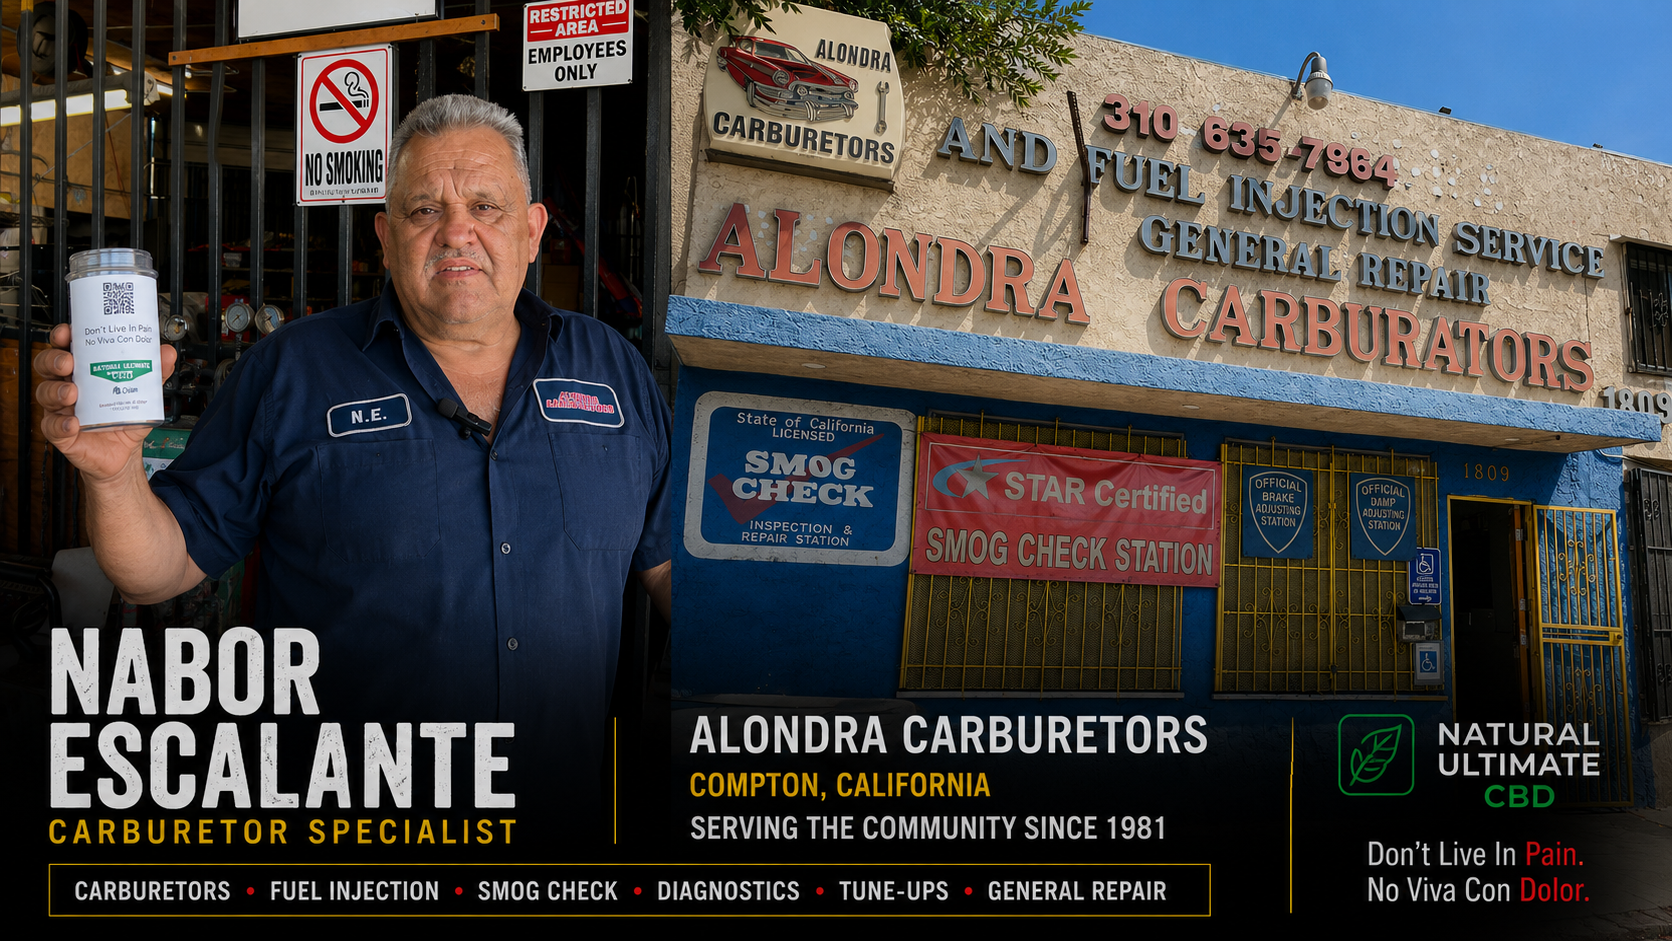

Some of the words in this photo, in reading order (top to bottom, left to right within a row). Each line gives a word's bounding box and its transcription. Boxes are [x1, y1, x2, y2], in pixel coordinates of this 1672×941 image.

[530, 0, 627, 23] RESTRICTED
[555, 19, 599, 37] AREA
[528, 40, 627, 64] EMPLOYEES
[814, 38, 891, 73] ALONDRA
[555, 63, 597, 82] ONLY
[1101, 93, 1179, 143] 310
[713, 111, 895, 164] CARBURETORS
[305, 153, 323, 186] NO
[326, 149, 383, 185] SMOKING
[937, 116, 1058, 175] AND
[1086, 144, 1206, 205] FUEL
[1228, 174, 1440, 247] INJECTION
[1453, 221, 1606, 280] SERVICE
[1139, 214, 1342, 283] GENERAL
[1357, 251, 1491, 306] REPAIR
[698, 202, 1090, 326] ALONDRA
[1161, 277, 1595, 393] CARBURATORS
[85, 326, 106, 336] Don't
[108, 325, 126, 333] Live
[128, 324, 136, 332] In
[85, 338, 96, 346] No
[117, 335, 134, 343] Con
[1602, 386, 1672, 424] 1809
[351, 408, 387, 424] N.E.
[737, 412, 777, 427] State
[785, 416, 801, 428] of
[810, 417, 874, 434] California
[772, 428, 835, 442] LICENSED
[745, 450, 856, 480] SMOG
[1464, 462, 1509, 482] 1809
[732, 477, 874, 508] CHECK
[1004, 471, 1085, 505] STAR
[1094, 479, 1207, 514] Certified
[1255, 477, 1302, 493] OFFICIAL
[1361, 484, 1405, 498] OFFICIAL
[1262, 492, 1295, 503] BRAKE
[1255, 503, 1301, 516] ADJUSTING
[1362, 508, 1405, 520] ADJUSTING
[750, 520, 833, 534] INSPECTION
[843, 525, 853, 535] &
[1261, 516, 1296, 527] STATION
[1368, 520, 1401, 531] STATION
[741, 532, 788, 544] REPAIR
[795, 534, 849, 547] STATION
[925, 527, 1009, 566] SMOG
[1017, 532, 1108, 571] CHECK
[1115, 538, 1213, 576] STATION
